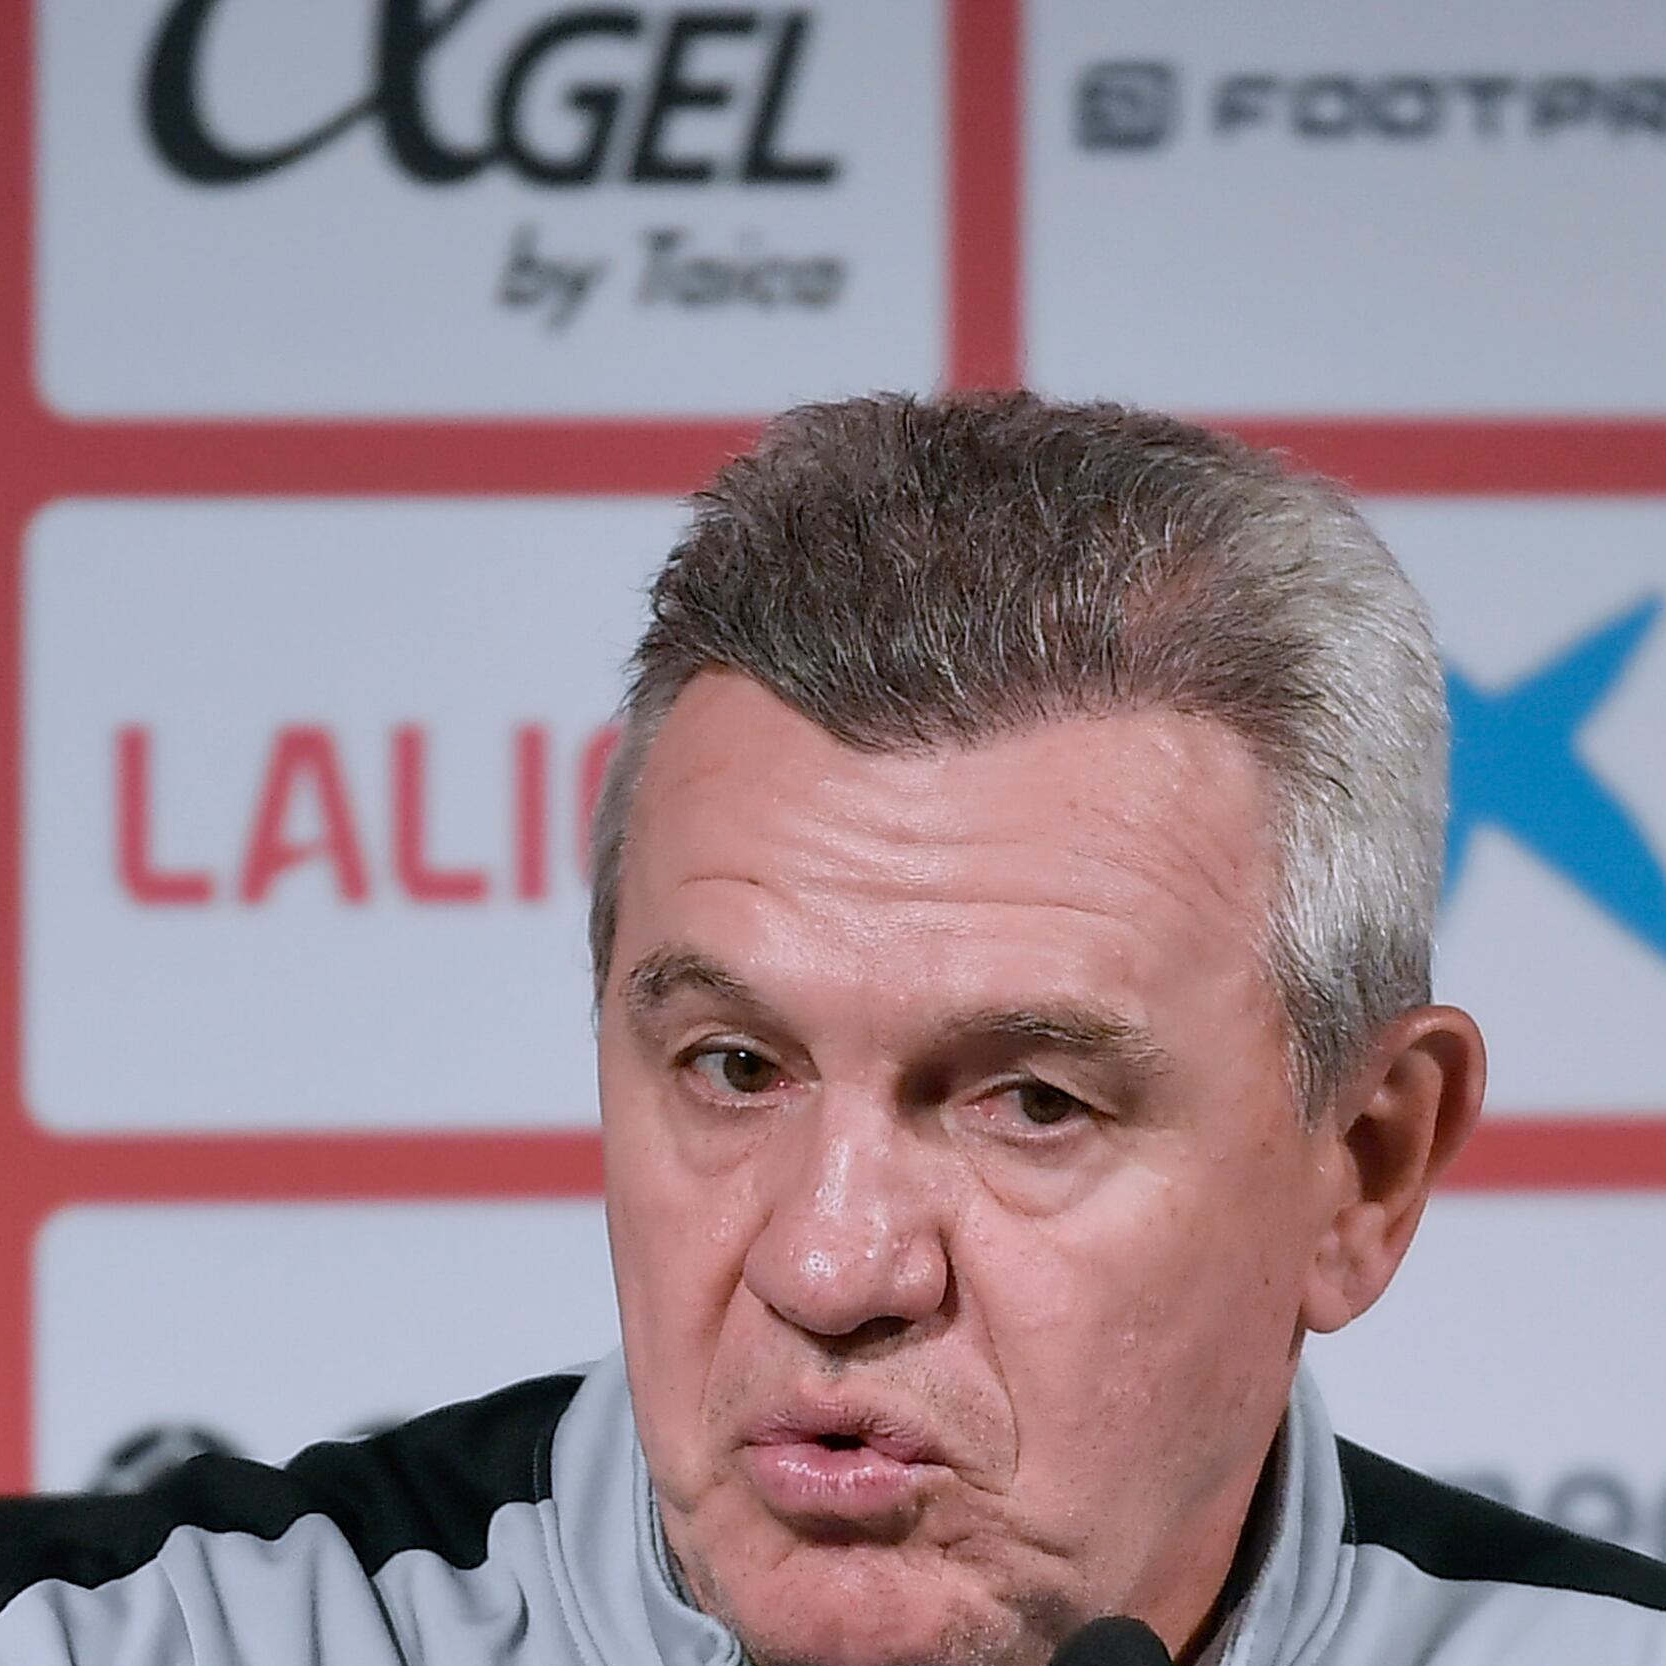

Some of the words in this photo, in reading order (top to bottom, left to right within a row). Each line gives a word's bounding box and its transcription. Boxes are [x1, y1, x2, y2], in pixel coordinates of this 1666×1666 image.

[501, 224, 601, 330] by
[635, 228, 845, 310] Taica
[113, 725, 619, 904] LALI
